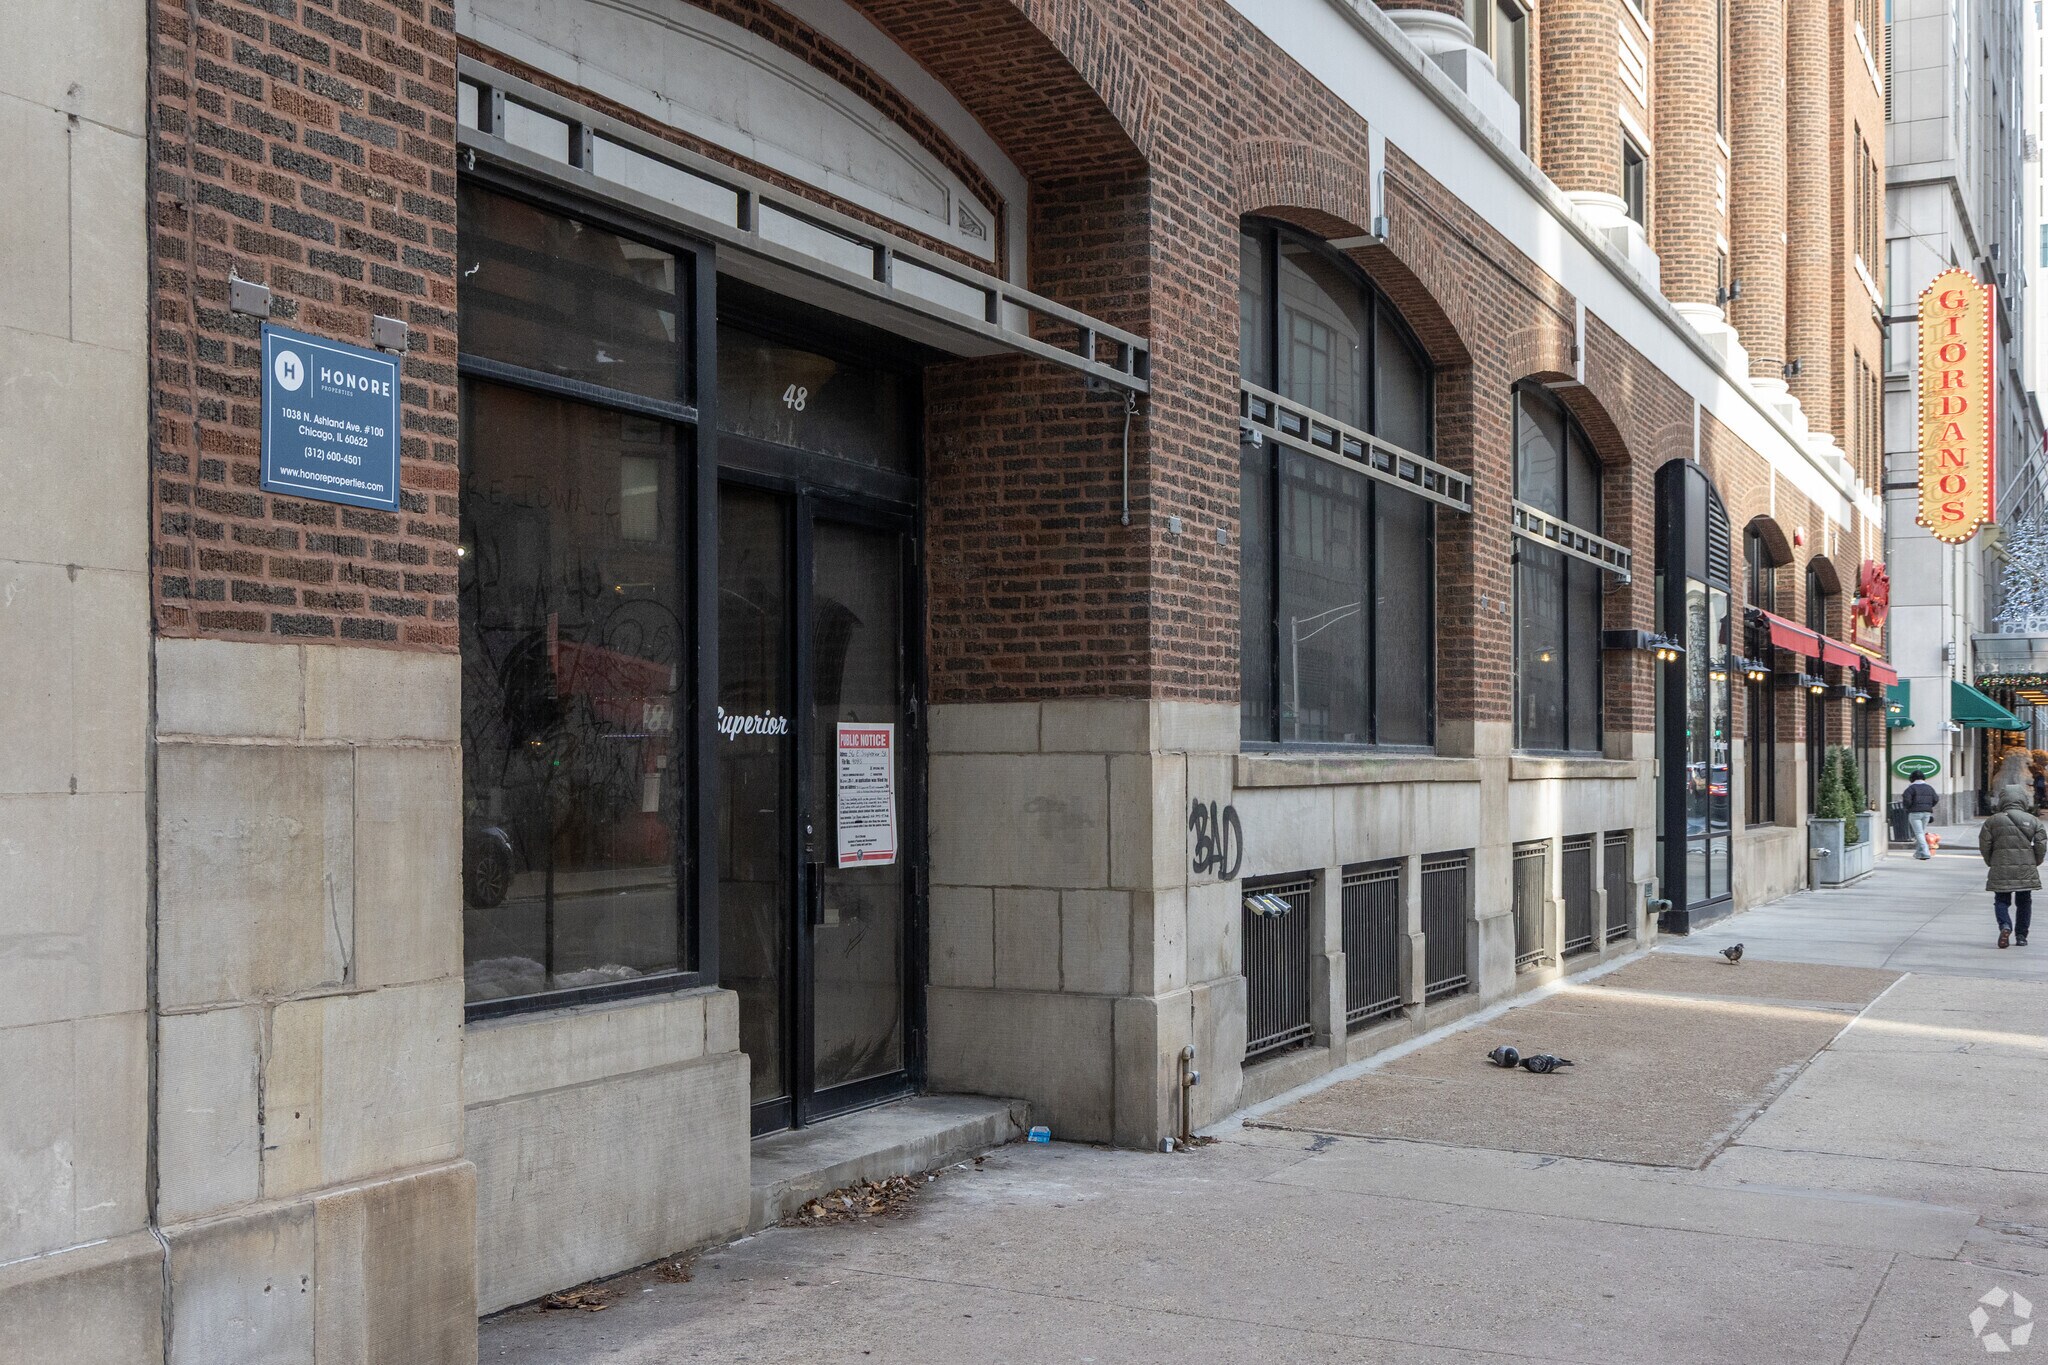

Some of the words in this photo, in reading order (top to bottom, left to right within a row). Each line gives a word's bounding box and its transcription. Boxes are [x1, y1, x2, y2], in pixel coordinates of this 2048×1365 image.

[321, 366, 390, 397] HONORE
[321, 384, 354, 397] PROPERTIES
[782, 383, 808, 412] 48
[282, 407, 302, 420] 1038
[303, 412, 312, 423] N.
[313, 414, 345, 430] Ashland
[345, 421, 363, 433] Ave.
[364, 425, 384, 438] #100
[298, 424, 335, 442] Chicago,
[336, 432, 343, 443] IL
[344, 434, 368, 448] 60622
[304, 446, 325, 461] (312)
[326, 450, 362, 466] 600-4501
[280, 466, 384, 492] www.honoreproperties.com
[840, 733, 859, 747] PUBLIC
[860, 733, 886, 747] NOTICE
[1189, 797, 1243, 880] BAD
